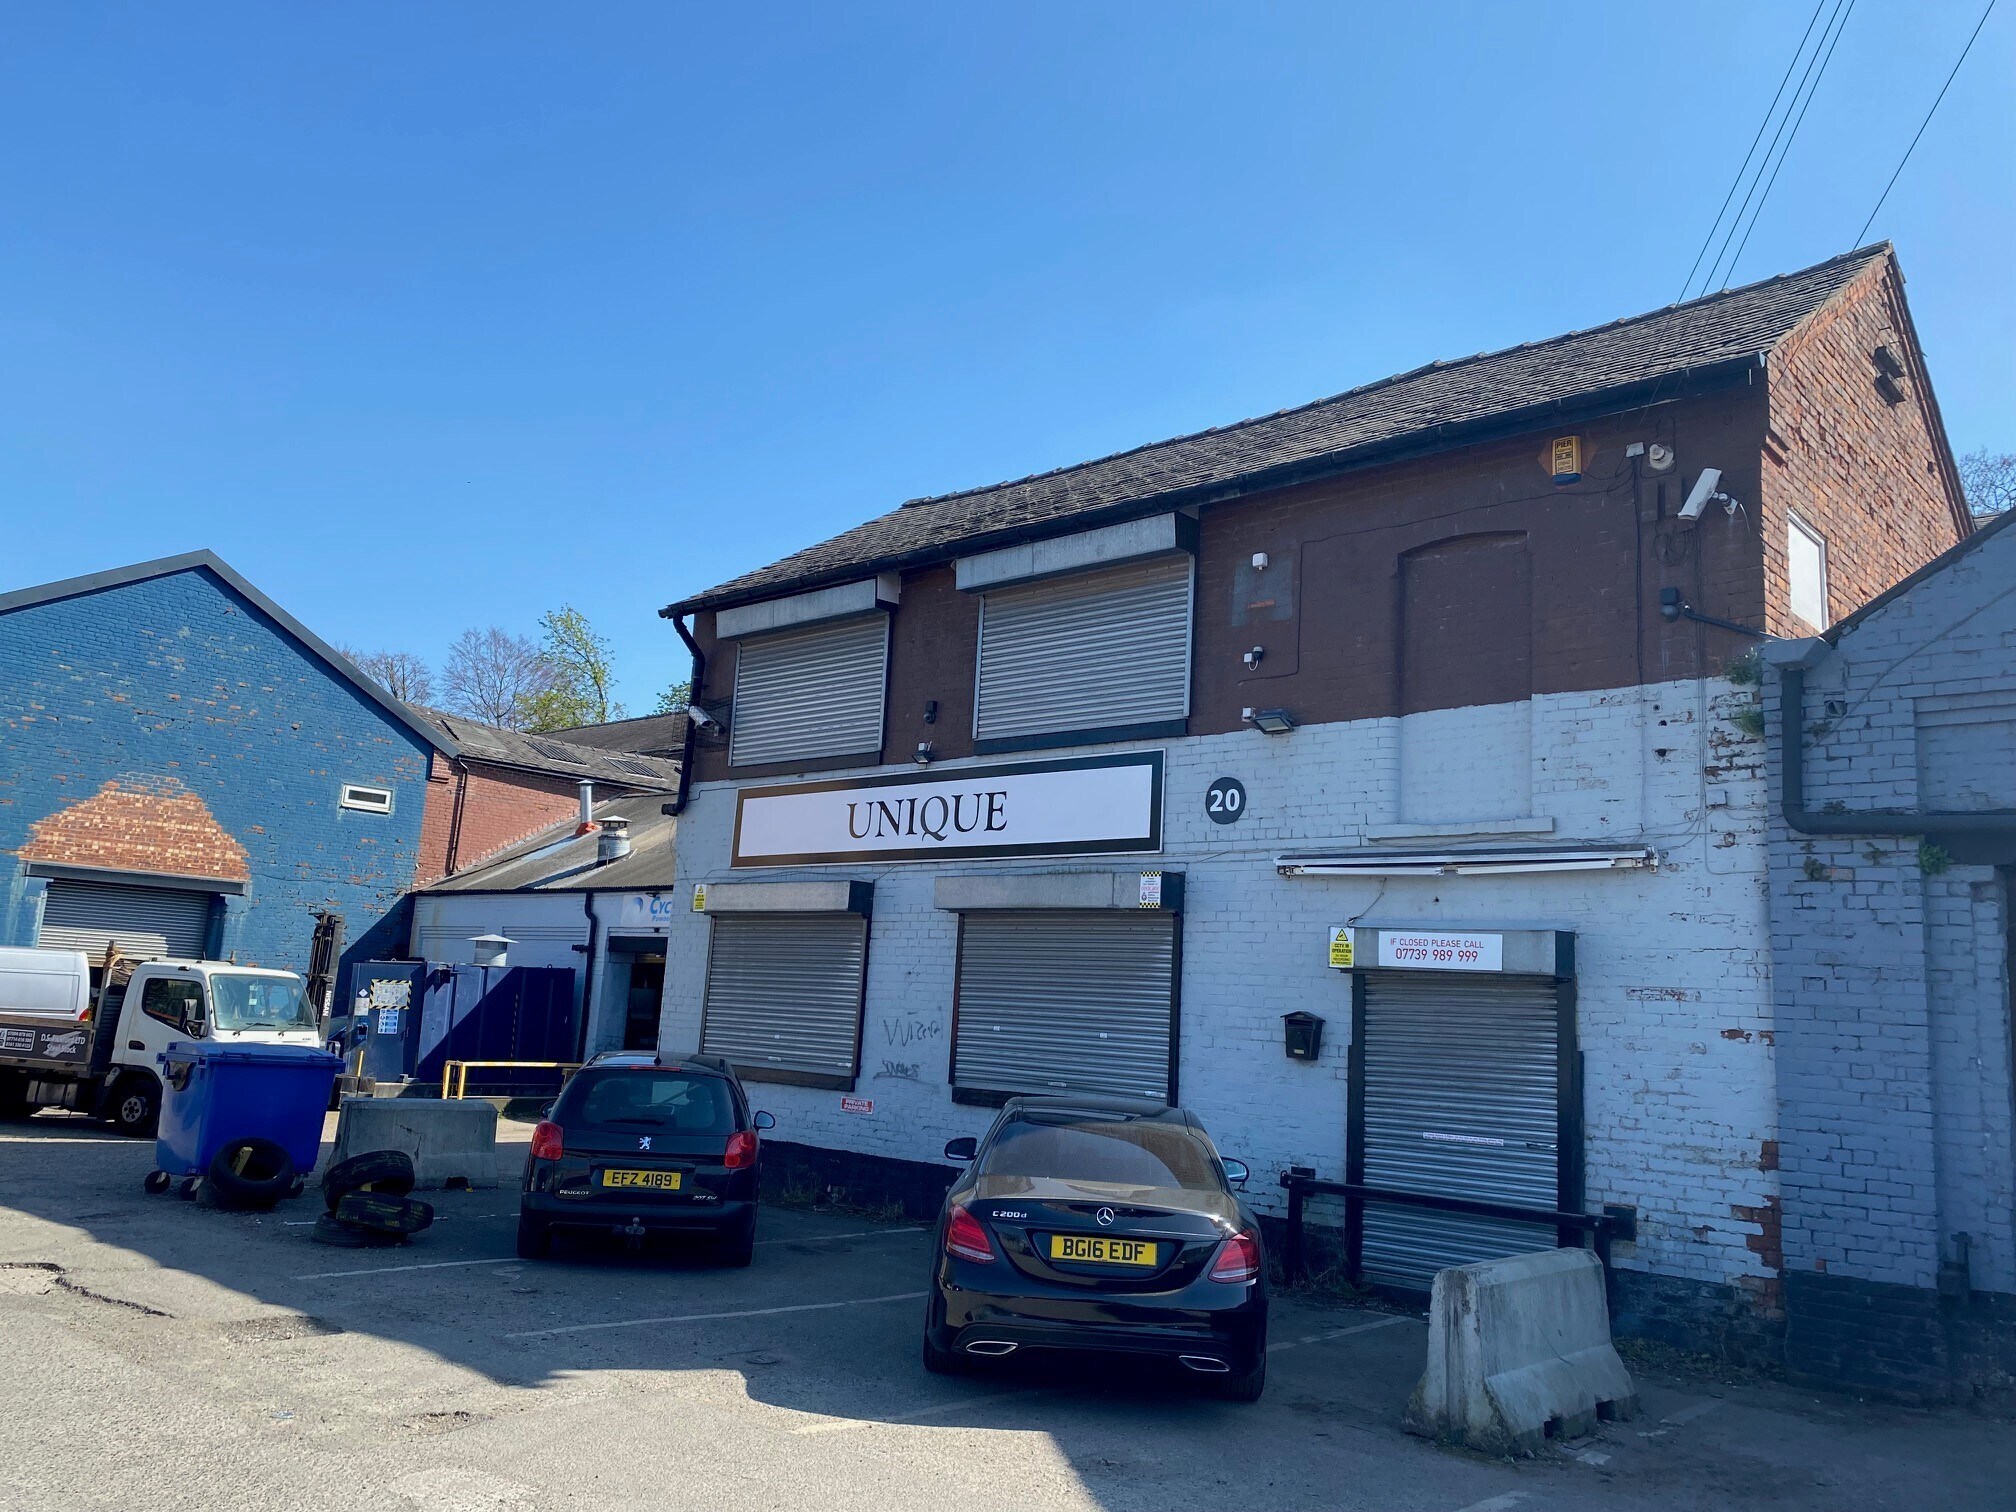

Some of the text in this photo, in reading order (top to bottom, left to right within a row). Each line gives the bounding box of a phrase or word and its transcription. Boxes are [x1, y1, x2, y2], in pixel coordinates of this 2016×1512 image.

[1557, 440, 1572, 448] PIER
[1209, 788, 1241, 812] 20
[847, 791, 1008, 842] UNIQUE
[1390, 938, 1484, 949] IF CLOSED PLEASE CALL
[1395, 948, 1478, 962] 07739 989 999
[322, 990, 332, 1017] NISSAN
[843, 1103, 870, 1112] PARKING
[845, 1099, 869, 1107] PRIVATE
[611, 1171, 673, 1187] EFZ 4189
[1062, 1238, 1146, 1262] BG16 EDF
